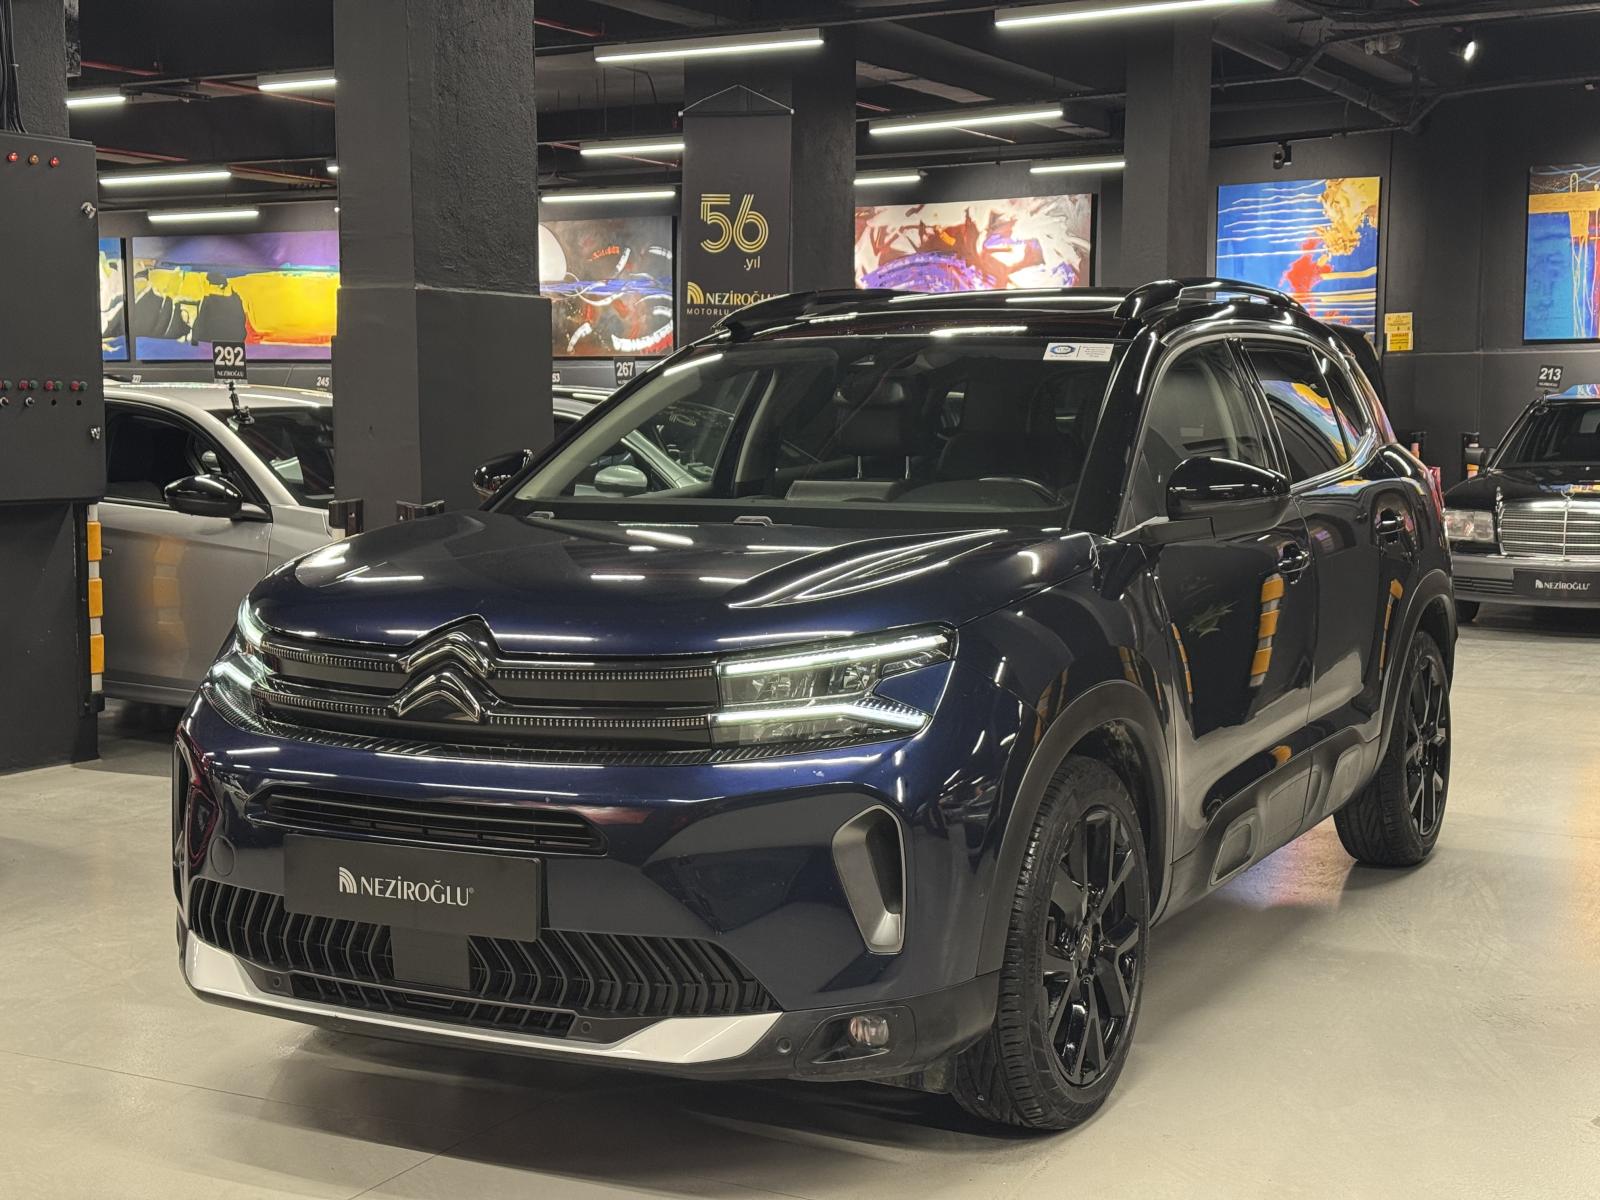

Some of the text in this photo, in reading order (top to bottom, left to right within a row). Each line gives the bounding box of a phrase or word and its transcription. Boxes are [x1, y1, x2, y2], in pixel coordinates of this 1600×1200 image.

[700, 193, 769, 253] 56
[686, 308, 730, 316] MOTORLU
[214, 345, 245, 366] 292
[616, 361, 634, 377] 267
[1539, 367, 1562, 381] 213
